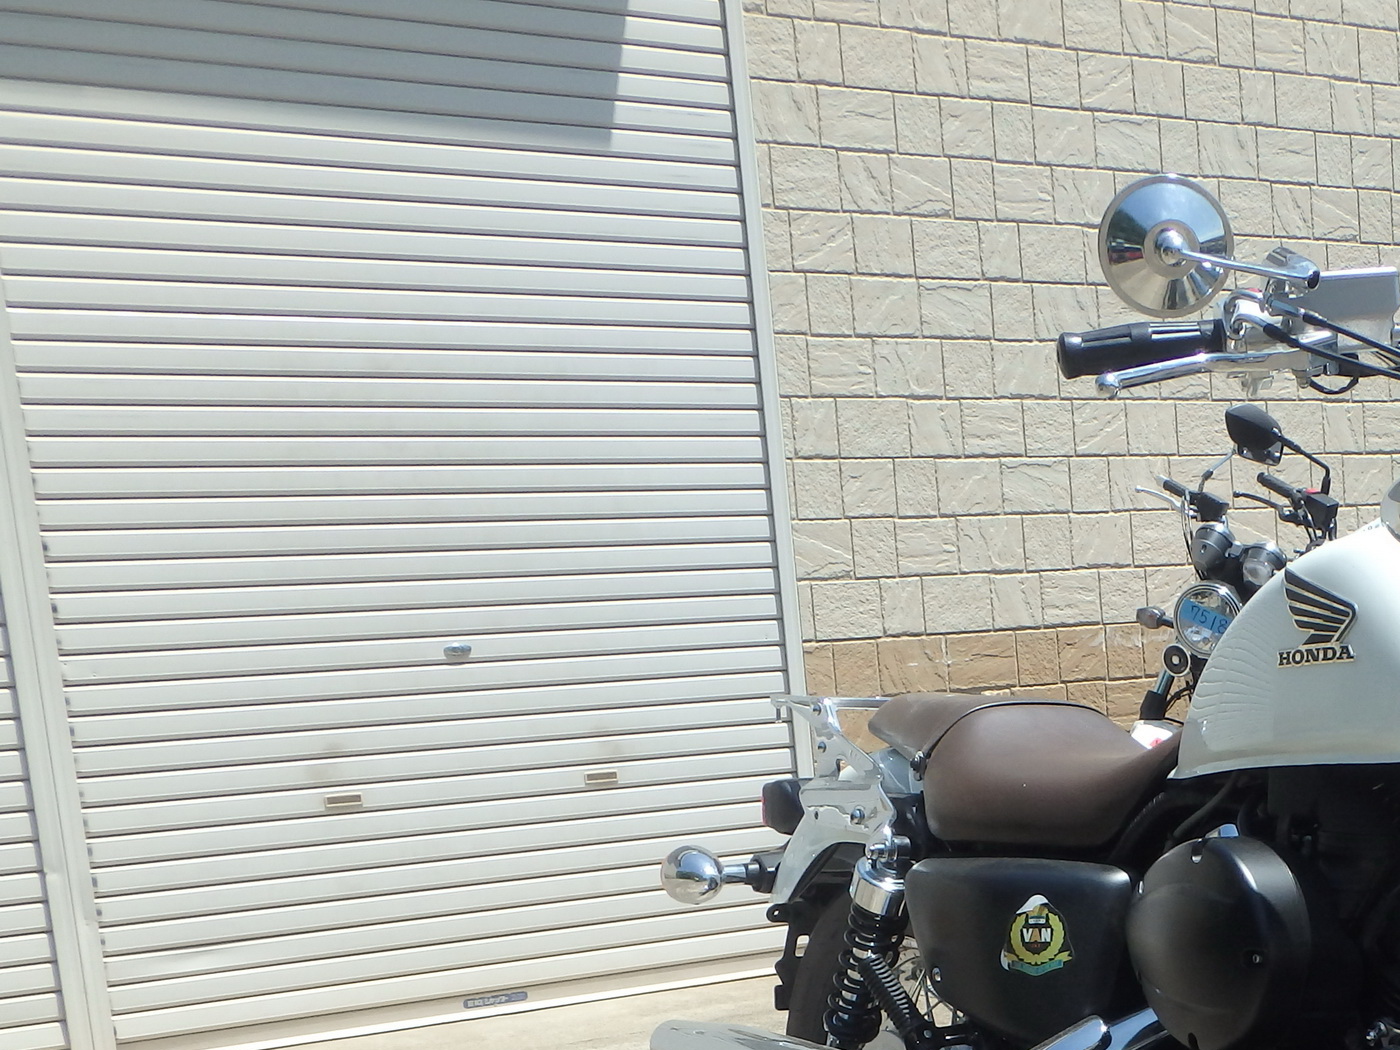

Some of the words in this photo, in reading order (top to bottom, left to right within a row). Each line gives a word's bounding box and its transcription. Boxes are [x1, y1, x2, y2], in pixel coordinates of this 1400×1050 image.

[1190, 605, 1228, 634] 7518
[1278, 644, 1355, 666] HONDA
[1022, 927, 1052, 943] VAN
